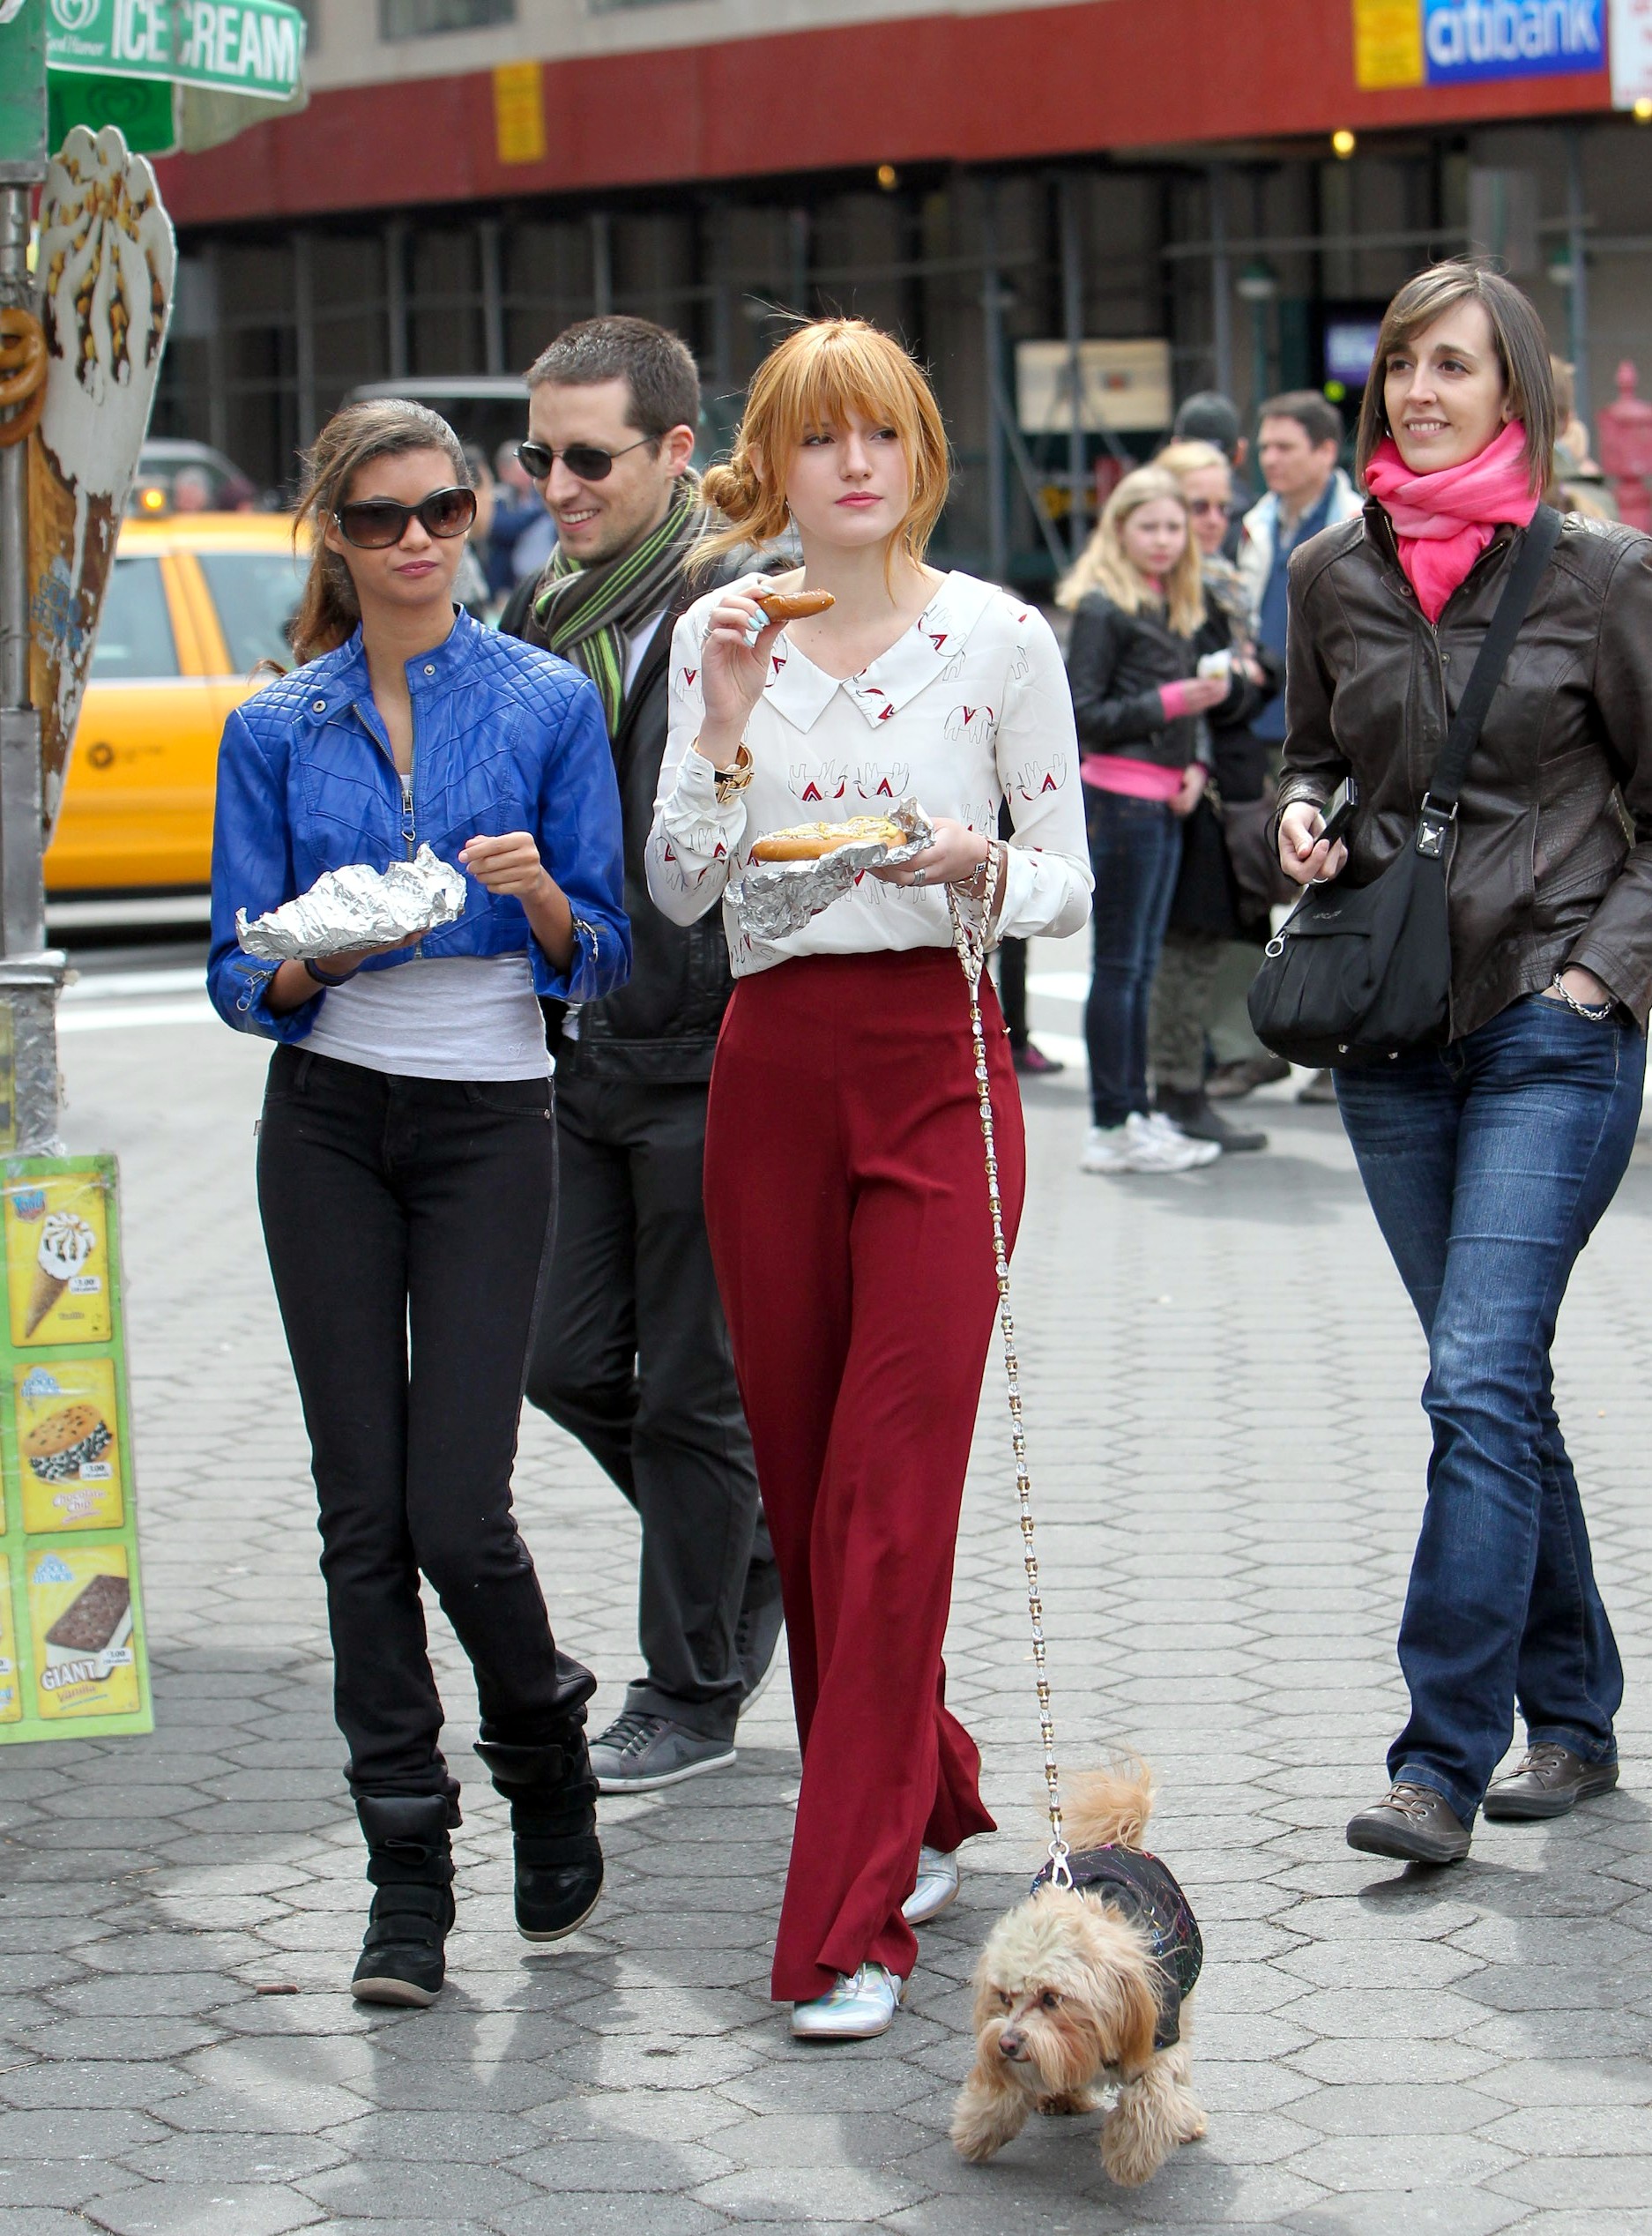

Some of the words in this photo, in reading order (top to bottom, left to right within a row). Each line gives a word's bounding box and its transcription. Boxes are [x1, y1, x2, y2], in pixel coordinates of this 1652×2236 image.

[111, 0, 169, 62] ICE
[1426, 0, 1600, 67] citibank
[41, 1659, 96, 1691] GIANT
